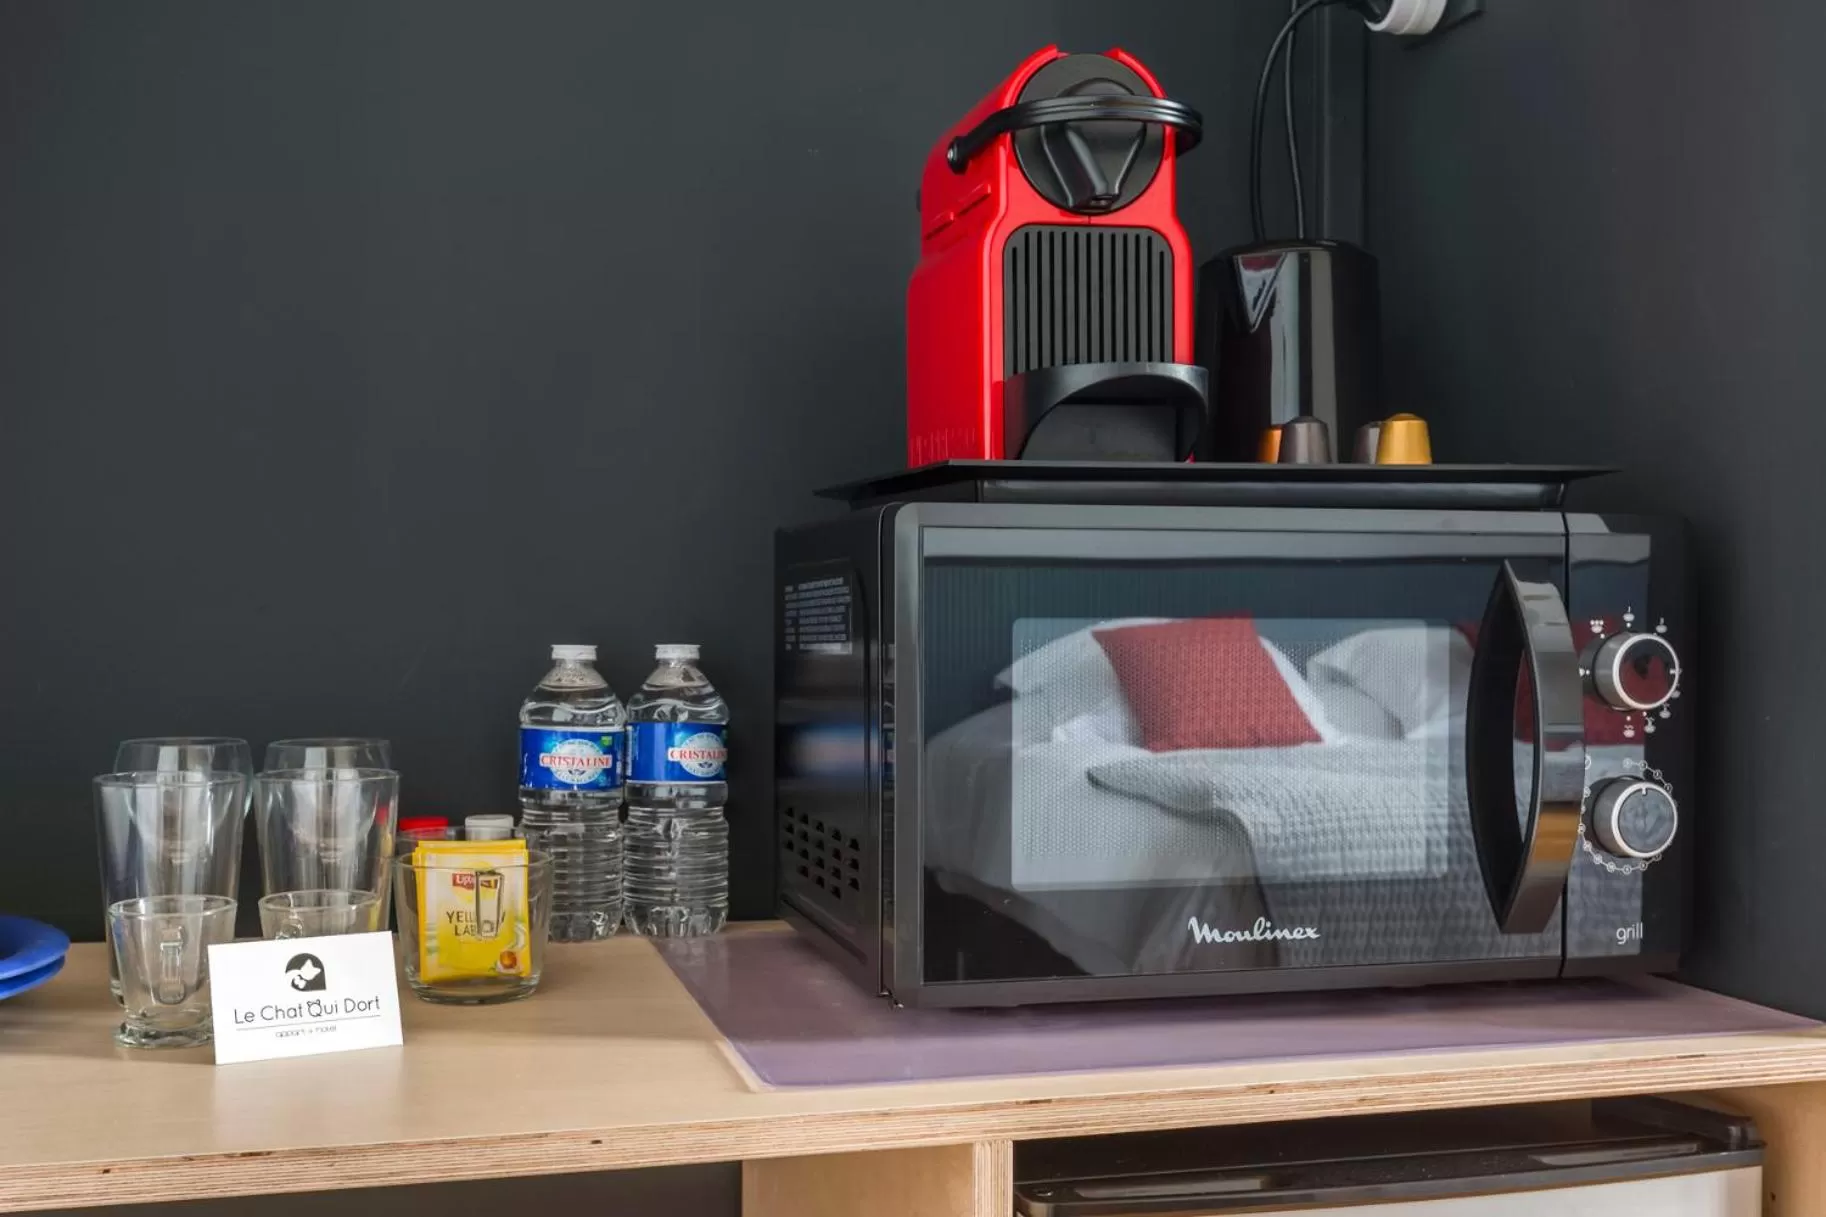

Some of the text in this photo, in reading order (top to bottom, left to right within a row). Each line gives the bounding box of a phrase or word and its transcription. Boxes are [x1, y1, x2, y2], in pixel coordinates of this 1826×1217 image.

[1188, 916, 1321, 944] Moulinex
[1616, 922, 1643, 945] grill
[234, 995, 380, 1024] Le Chat Qui Dort
